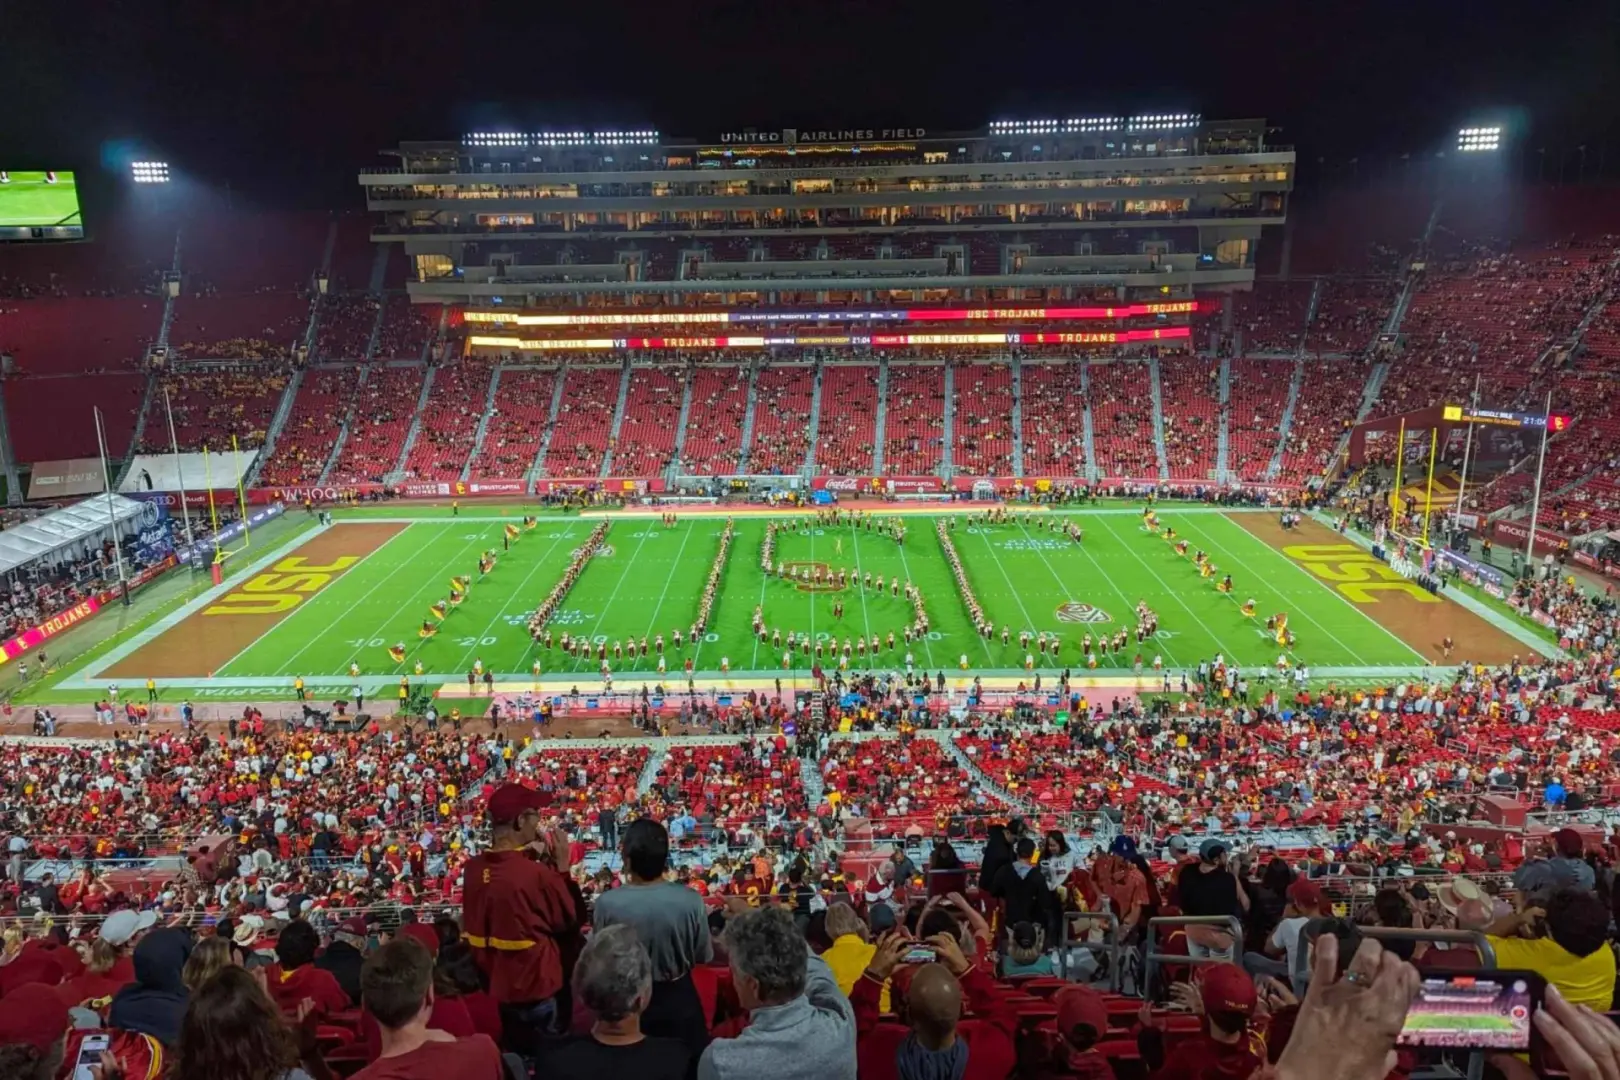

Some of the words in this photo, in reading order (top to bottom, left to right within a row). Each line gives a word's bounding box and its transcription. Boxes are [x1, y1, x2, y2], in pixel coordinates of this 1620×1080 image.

[721, 132, 779, 142] UNITED
[801, 130, 873, 141] AIRLINES
[882, 128, 926, 139] FIELD
[1147, 302, 1192, 313] TROJANS
[967, 309, 989, 318] USC
[993, 309, 1045, 318] TROJANS
[568, 315, 616, 324] ARIZONA
[659, 314, 679, 322] SUN
[1007, 334, 1020, 342] VS
[1059, 333, 1116, 342] TROJANS
[614, 339, 627, 347] VS
[662, 338, 716, 347] TROJANS
[1523, 417, 1546, 426] 21:04
[1282, 544, 1444, 603] USC
[201, 556, 361, 615] USC
[37, 602, 92, 638] TROJANS
[353, 638, 385, 647] 10
[459, 637, 497, 646] 20
[194, 685, 350, 697] ITRSTCAPITAL
